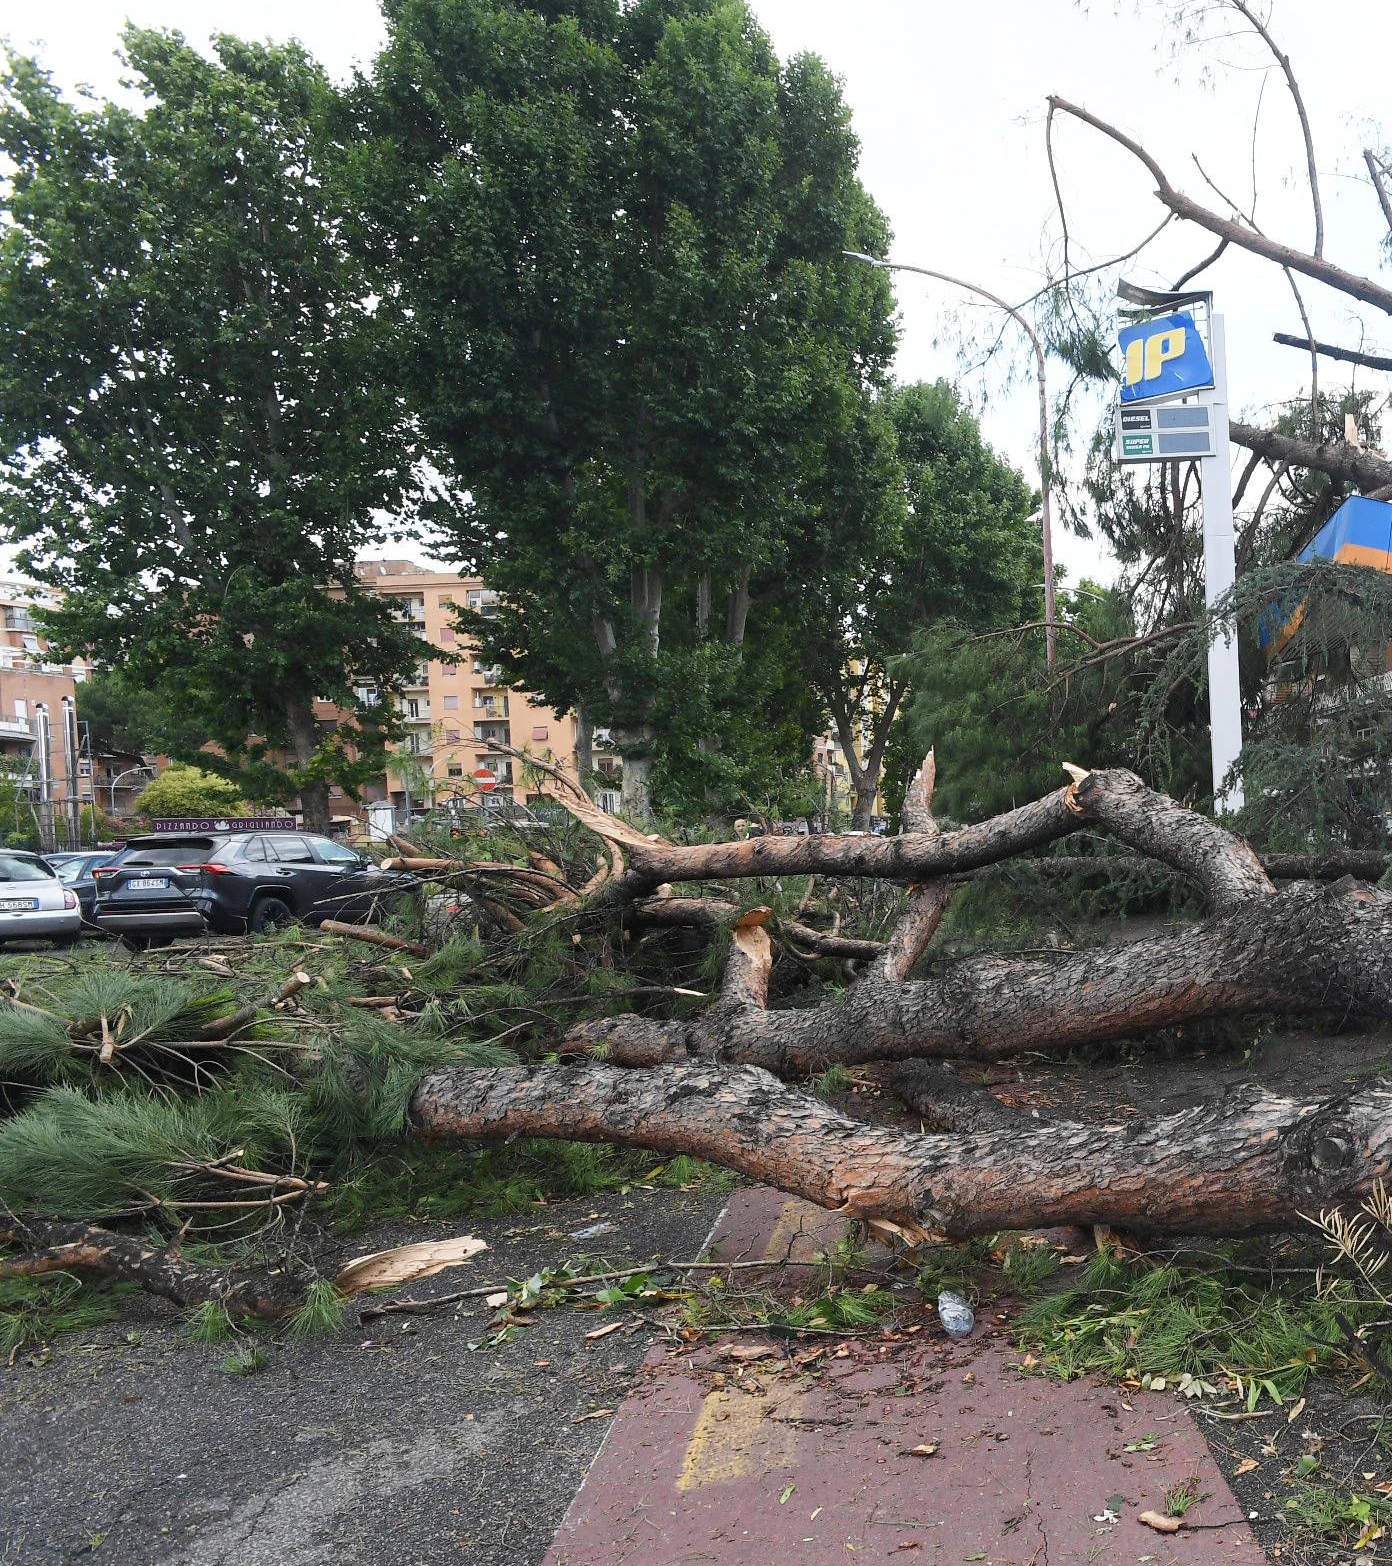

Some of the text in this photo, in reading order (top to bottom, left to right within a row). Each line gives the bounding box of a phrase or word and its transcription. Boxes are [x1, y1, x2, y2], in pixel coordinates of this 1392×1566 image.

[1126, 327, 1186, 386] IP
[1122, 415, 1151, 423] DIESEL
[156, 820, 294, 831] PIZZANDO GRIGLIANDO
